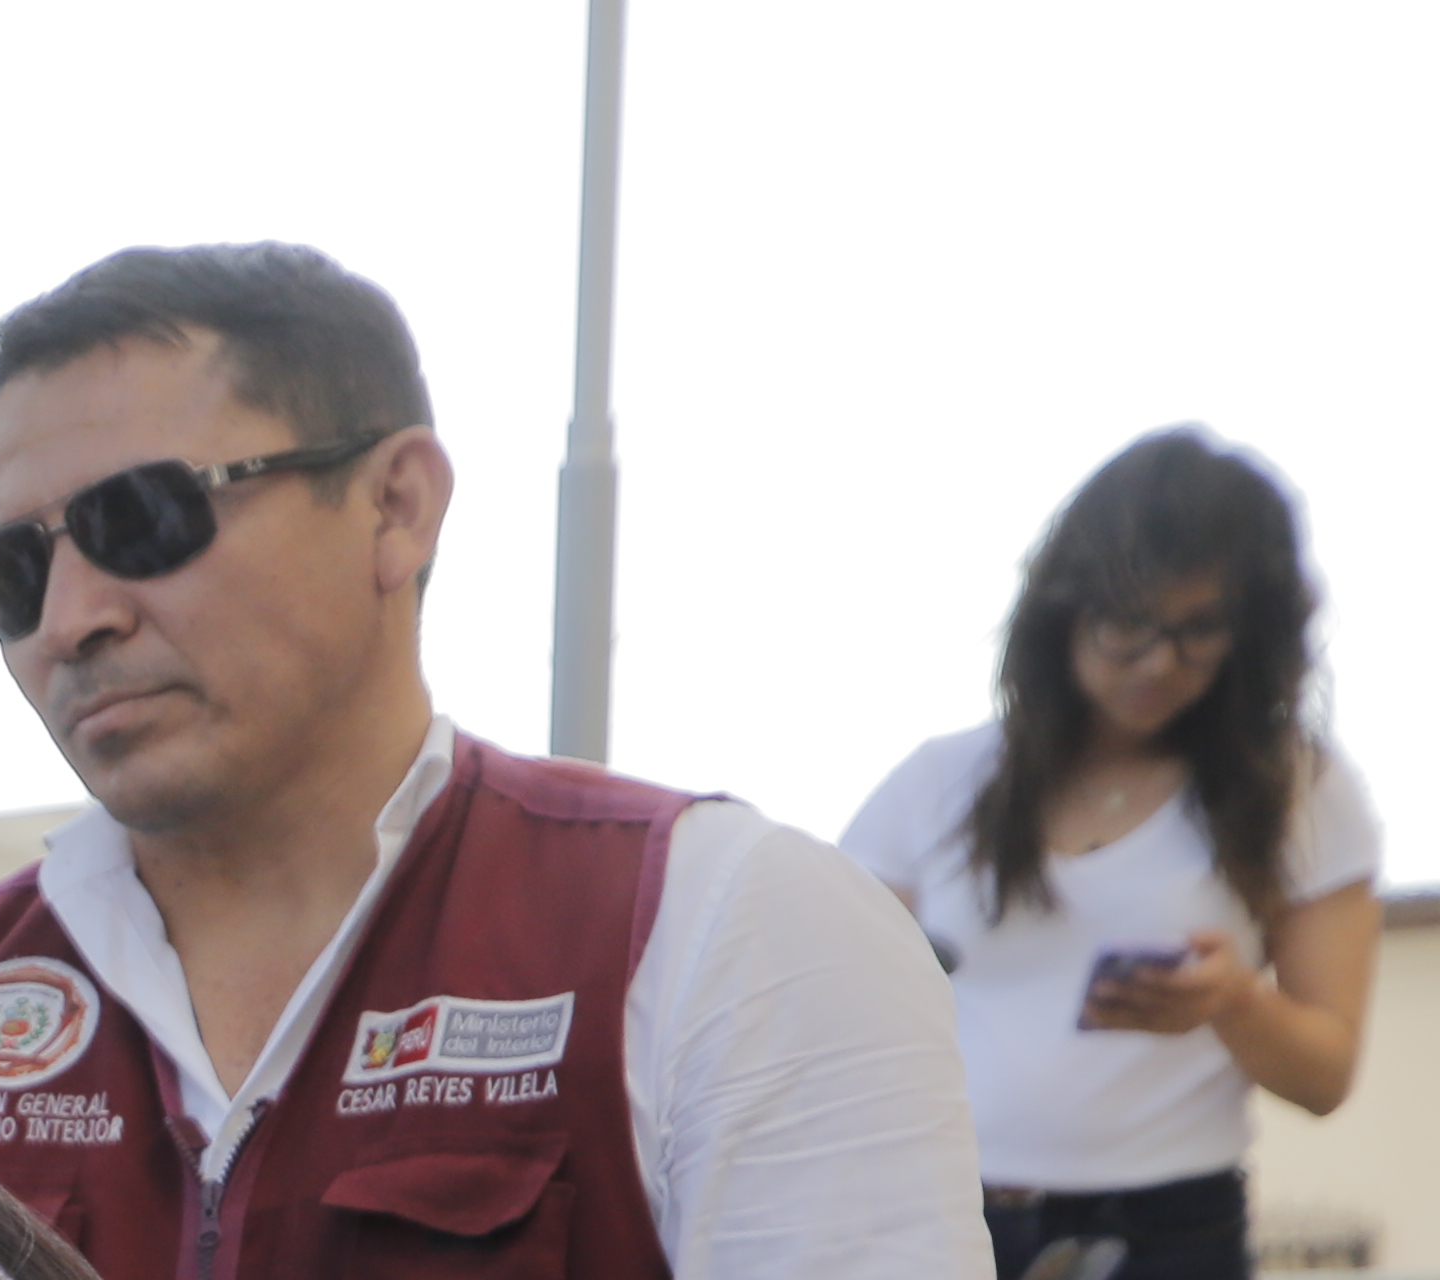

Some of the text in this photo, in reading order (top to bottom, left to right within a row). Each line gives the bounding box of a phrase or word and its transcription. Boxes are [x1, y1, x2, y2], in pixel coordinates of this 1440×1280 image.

[450, 1010, 560, 1033] Ministerio
[443, 1033, 556, 1051] del Interior
[16, 1091, 110, 1117] GENERAL
[336, 1069, 559, 1116] CESAR REYES VILELA
[25, 1114, 125, 1143] INTERIOR
